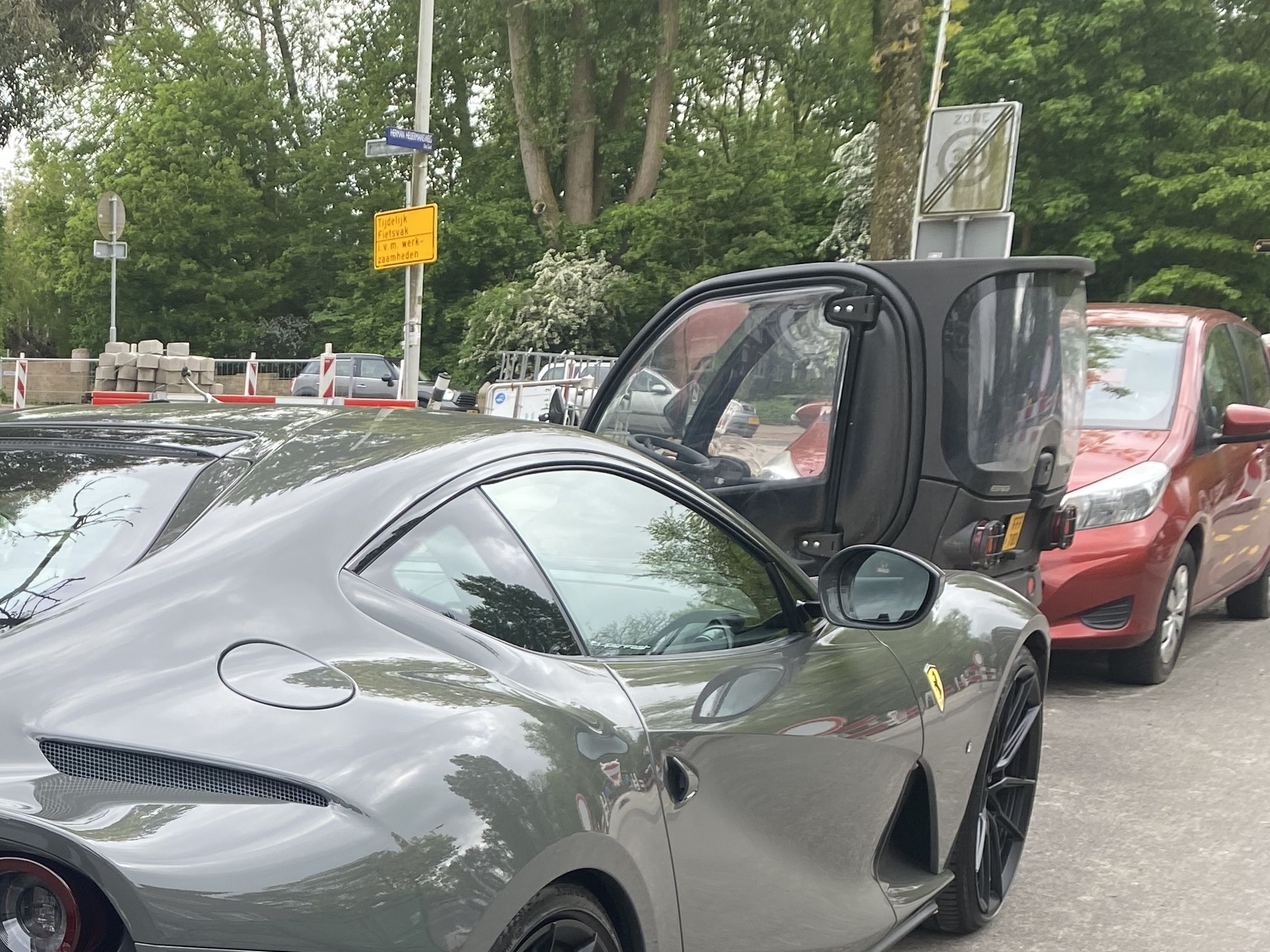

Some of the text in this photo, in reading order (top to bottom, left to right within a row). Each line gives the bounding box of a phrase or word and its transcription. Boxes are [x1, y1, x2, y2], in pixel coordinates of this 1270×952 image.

[953, 112, 991, 126] ZONE
[378, 214, 408, 229] Tijdelijk
[378, 226, 409, 239] Fietsvak
[402, 237, 424, 248] werk-
[378, 250, 419, 264] zaamheden
